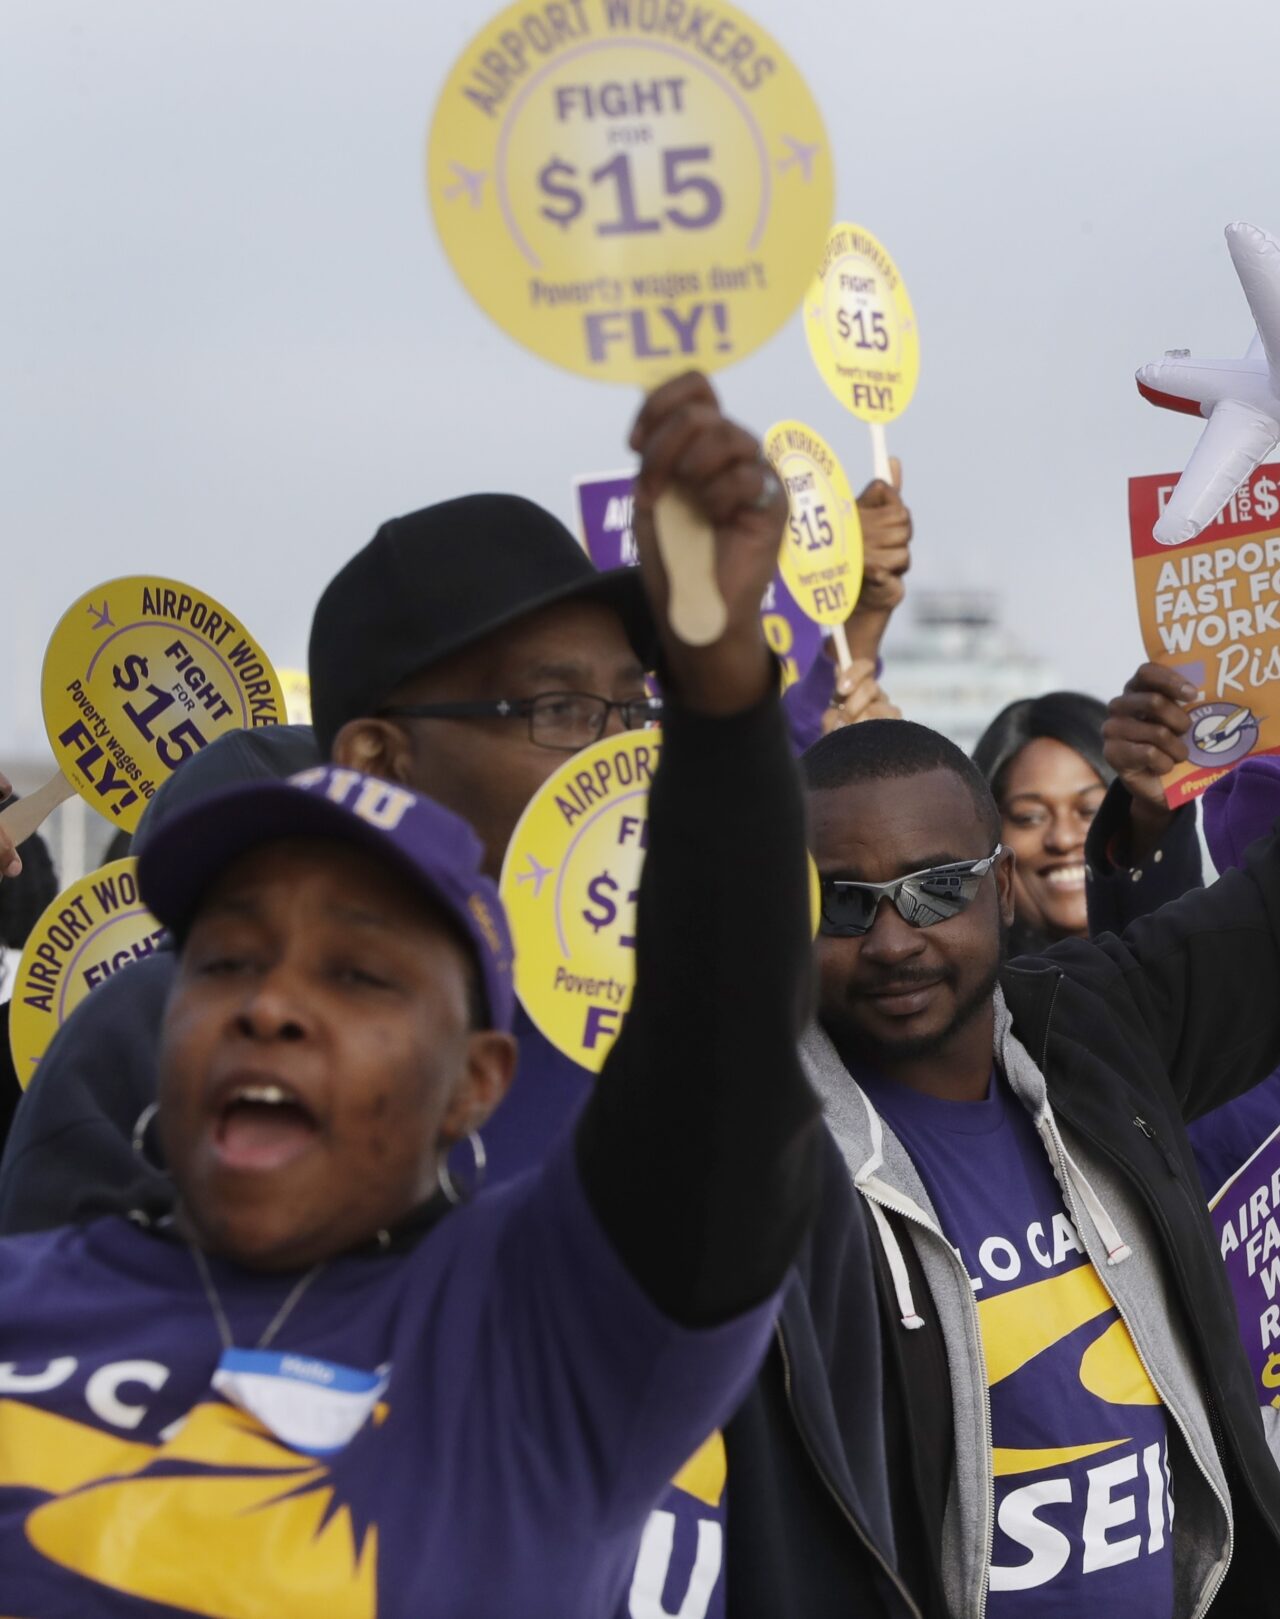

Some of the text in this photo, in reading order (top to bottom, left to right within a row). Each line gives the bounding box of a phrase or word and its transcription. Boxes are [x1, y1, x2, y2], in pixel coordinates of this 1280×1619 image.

[462, 0, 777, 118] AIRPORT WORKERS
[554, 78, 687, 121] FIGHT
[535, 146, 725, 238] $15
[582, 302, 733, 365] FLY!
[837, 307, 889, 351] $15
[853, 383, 894, 412] FLY!
[789, 505, 834, 551] $15
[812, 582, 849, 615] FLY!
[1155, 579, 1237, 624] FAST
[141, 586, 279, 727] AIRPORT WORKE
[164, 639, 234, 722] FIGHT
[66, 678, 110, 739] Poverty
[106, 735, 143, 782] wages
[112, 654, 209, 771] $15
[171, 682, 196, 713] FOR
[1188, 706, 1214, 723] EIU
[58, 719, 139, 816] FLY!
[23, 894, 94, 1013] AIRPORT
[554, 966, 626, 1004] Poverty
[953, 1212, 1088, 1293] LOCA
[989, 1442, 1176, 1592] SEI
